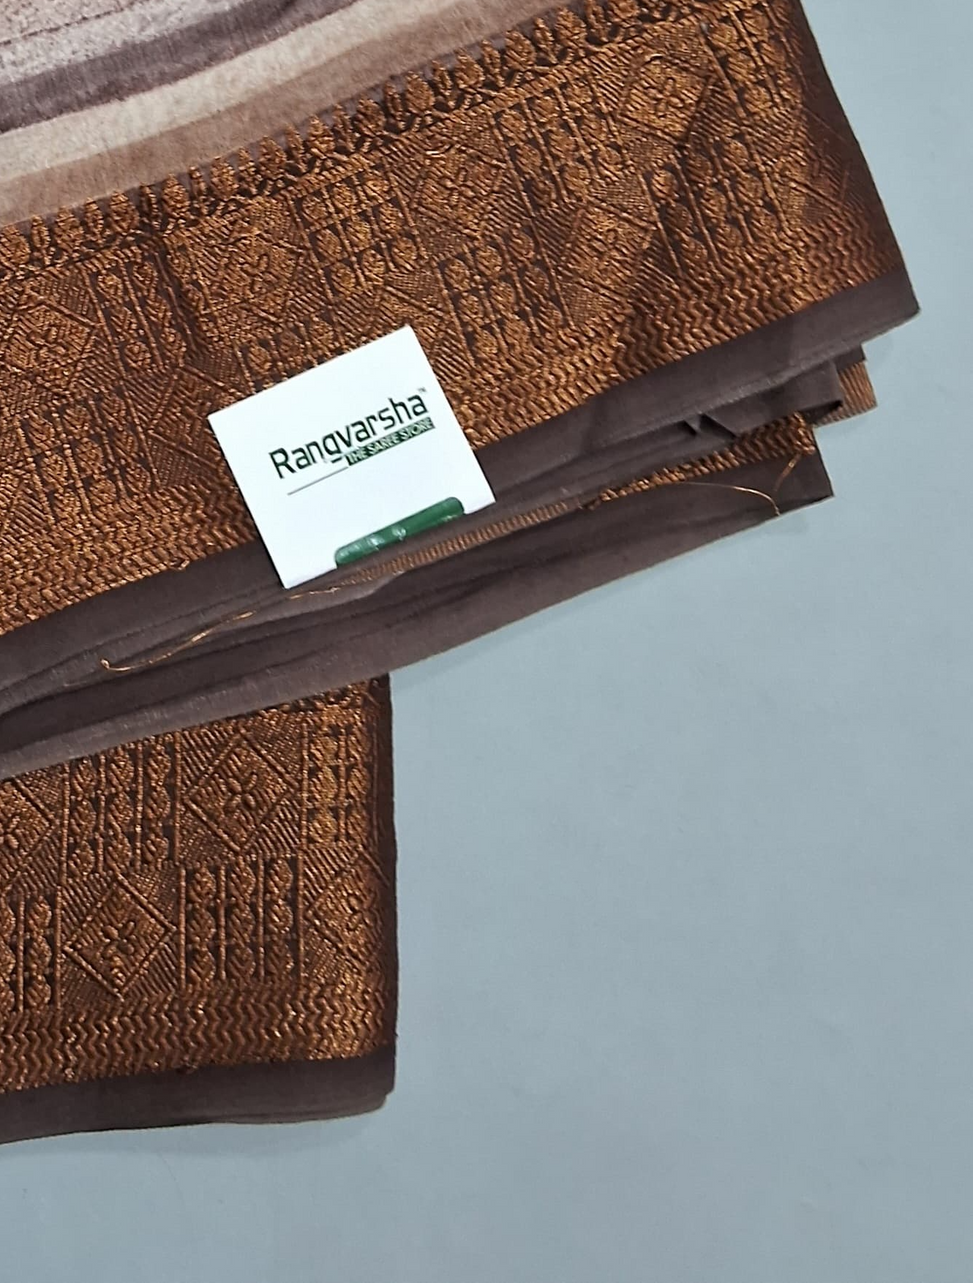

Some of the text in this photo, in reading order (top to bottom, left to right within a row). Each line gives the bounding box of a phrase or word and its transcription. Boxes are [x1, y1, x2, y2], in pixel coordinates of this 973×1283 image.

[269, 394, 427, 479] Rangvarsha
[347, 417, 434, 464] THE SAREE STORE
